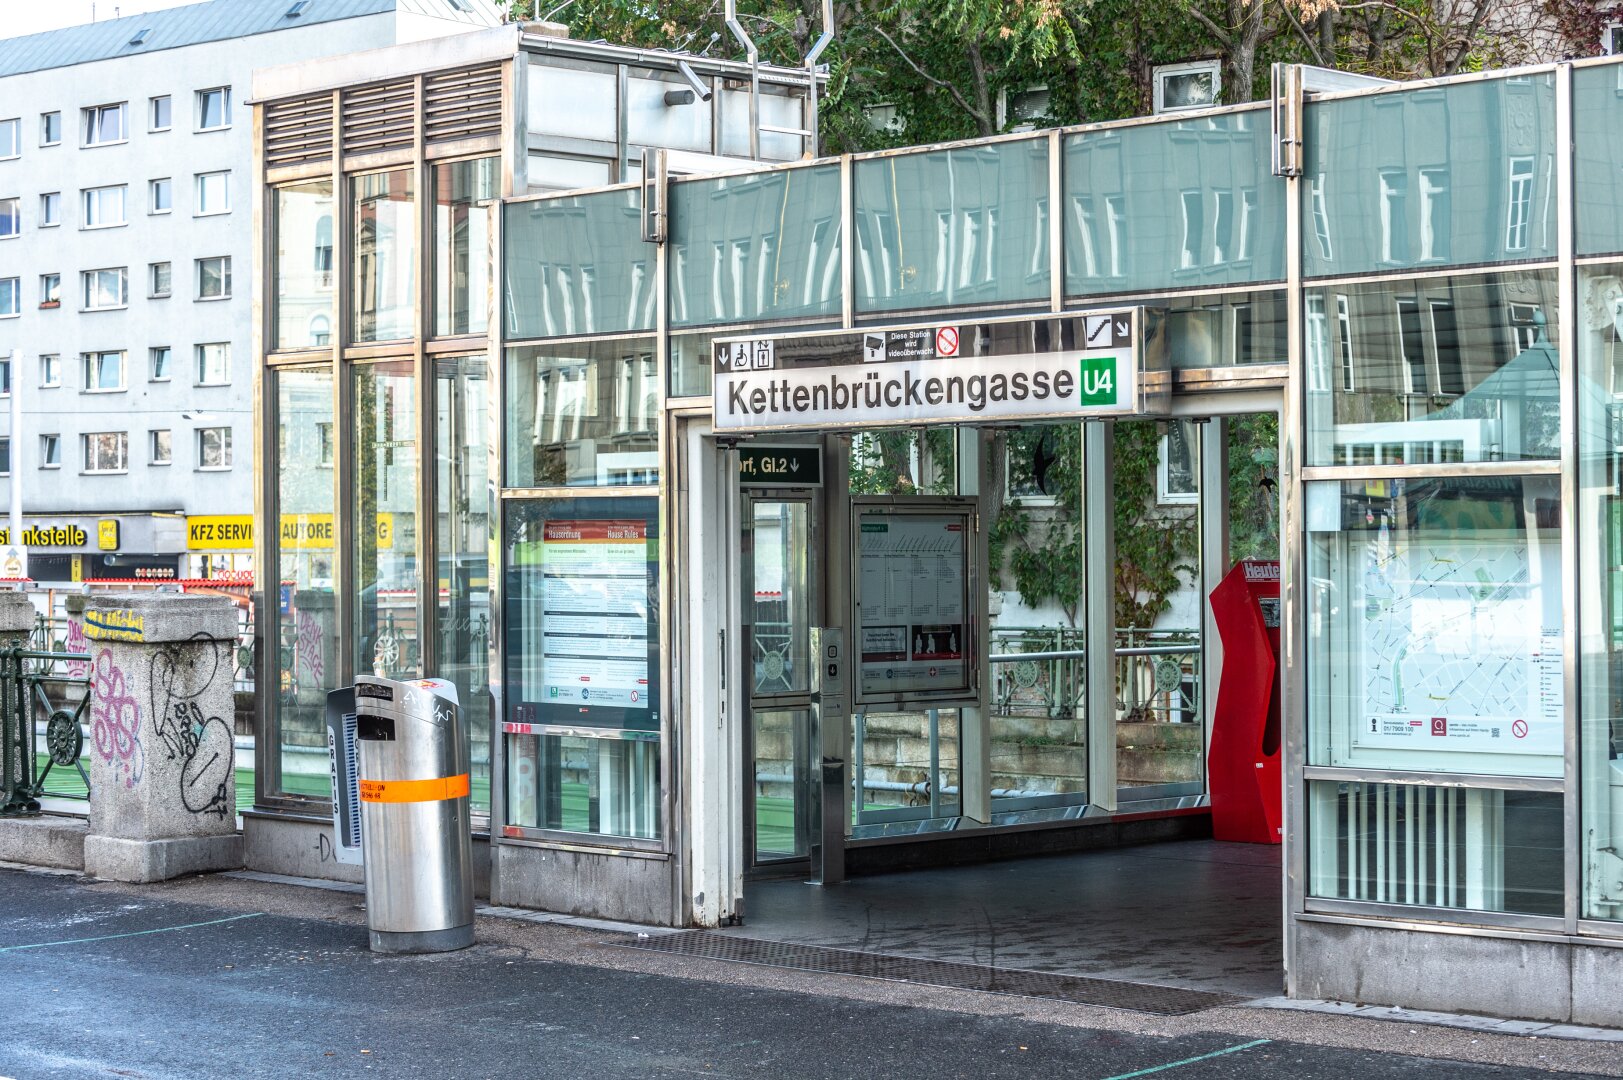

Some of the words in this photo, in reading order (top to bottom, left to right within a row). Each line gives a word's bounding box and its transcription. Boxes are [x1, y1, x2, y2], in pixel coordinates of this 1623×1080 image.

[909, 331, 931, 339] Station
[888, 347, 934, 357] videoüberwacht
[728, 368, 1075, 416] Kettenbrückengasse
[1083, 368, 1114, 396] U4
[0, 524, 87, 546] stnkstelle
[190, 523, 214, 541] KFZ
[216, 522, 254, 542] SERVI
[607, 530, 623, 539] House
[1243, 562, 1281, 579] Heute
[328, 734, 339, 815] GRATIS
